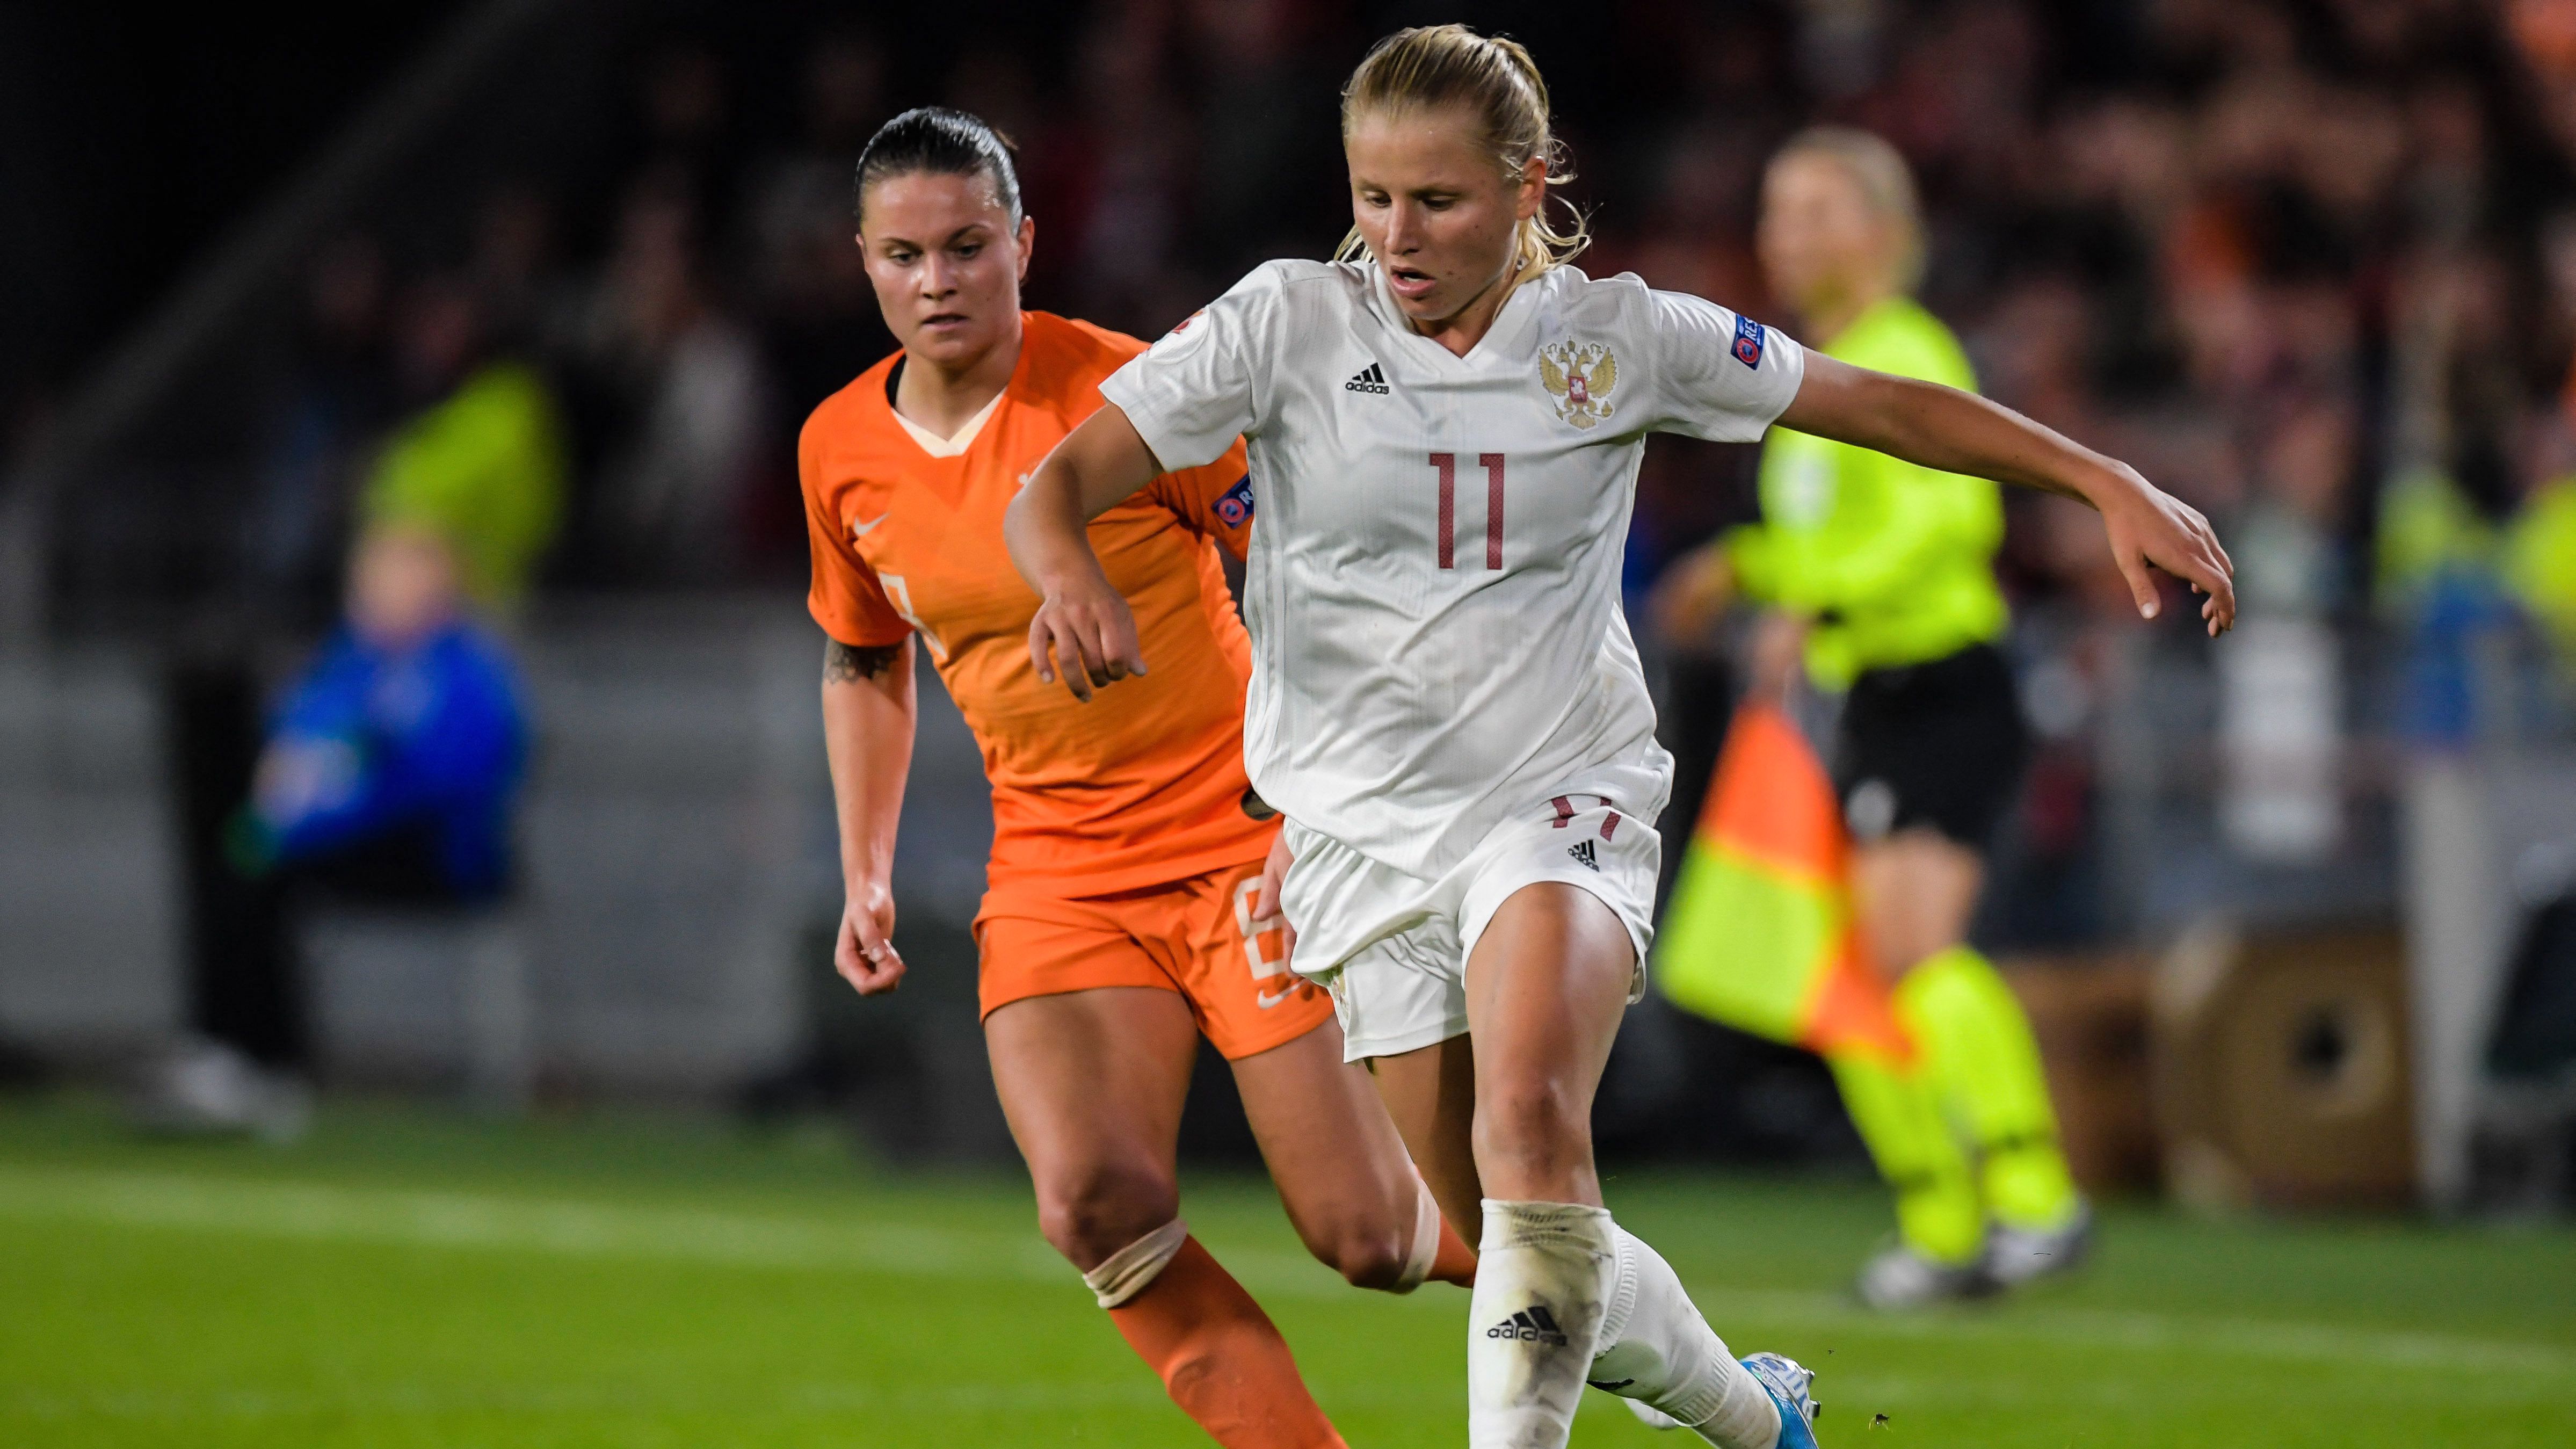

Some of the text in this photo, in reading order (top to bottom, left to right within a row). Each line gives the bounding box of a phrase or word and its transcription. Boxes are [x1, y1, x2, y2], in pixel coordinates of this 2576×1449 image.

[1345, 382, 1389, 395] adidas
[1429, 453, 1504, 570] 11
[1568, 848, 1599, 872] adidas
